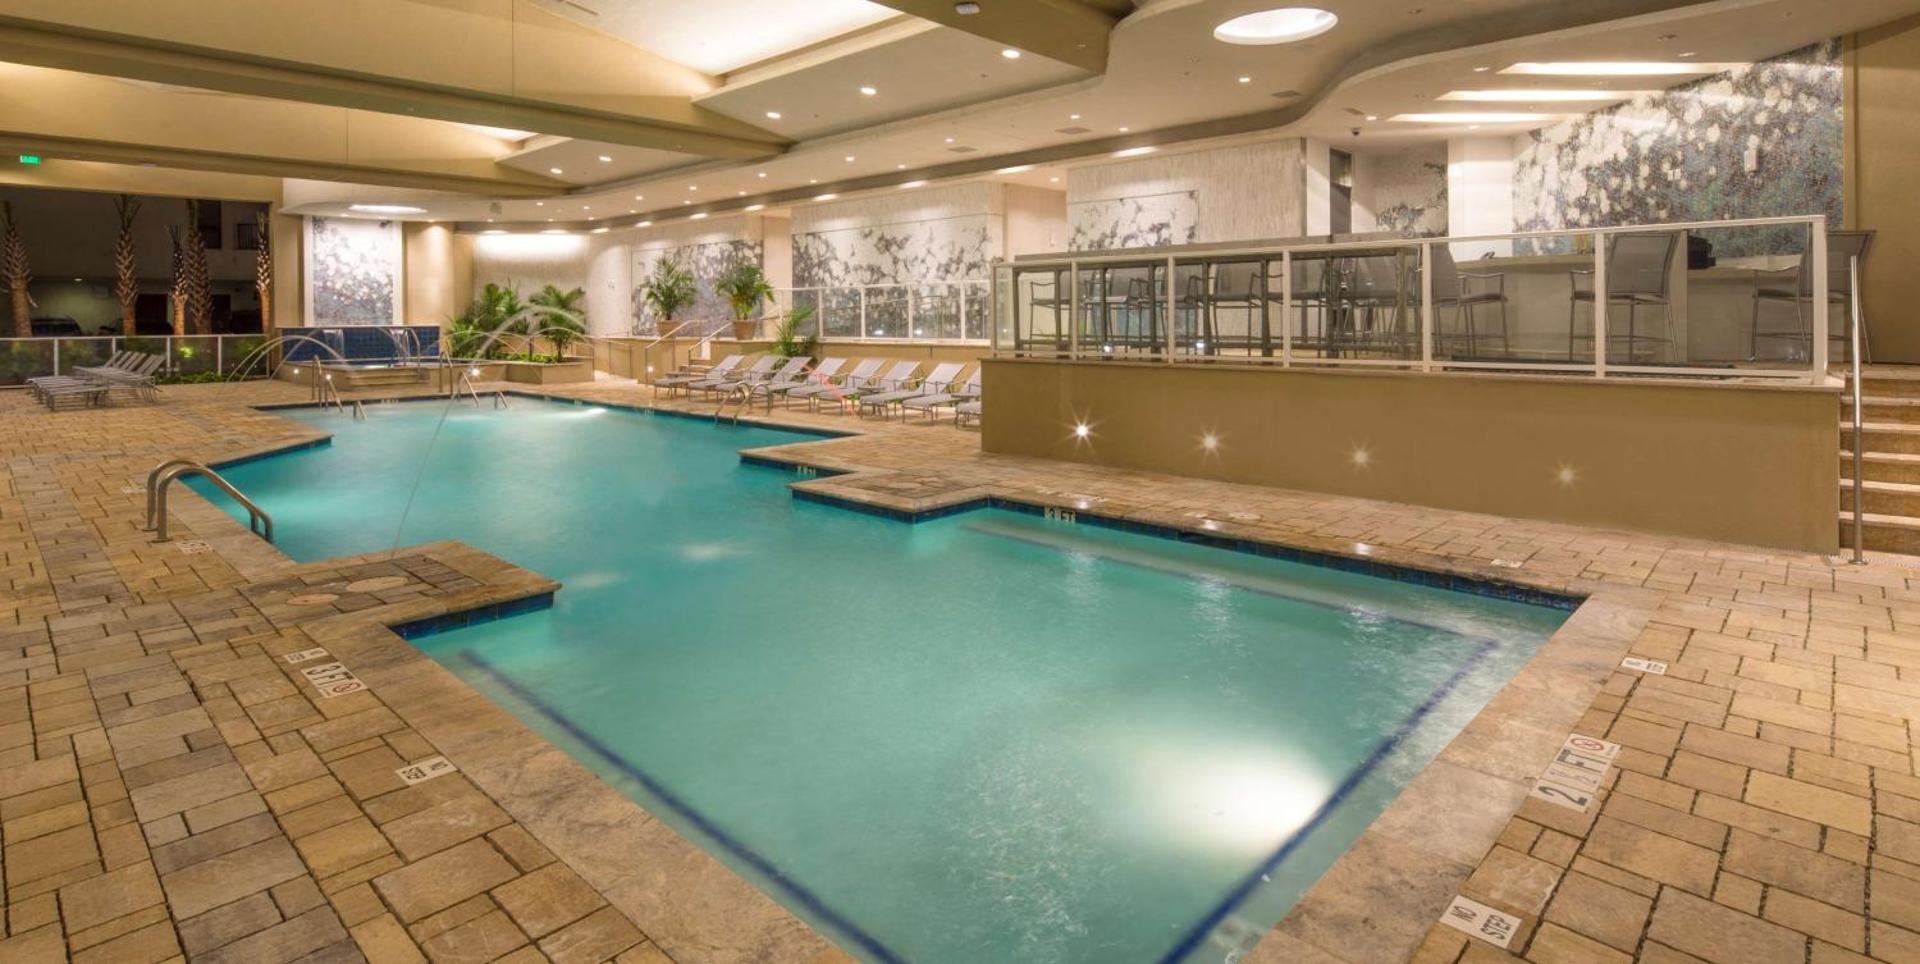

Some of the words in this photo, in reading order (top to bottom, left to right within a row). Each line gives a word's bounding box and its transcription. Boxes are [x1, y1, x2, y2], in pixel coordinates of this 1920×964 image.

[307, 664, 341, 675] 3
[313, 671, 354, 686] FT
[1556, 749, 1607, 773] FT
[1537, 786, 1588, 806] 2
[1450, 905, 1477, 923] NO
[1479, 914, 1512, 940] STEP
